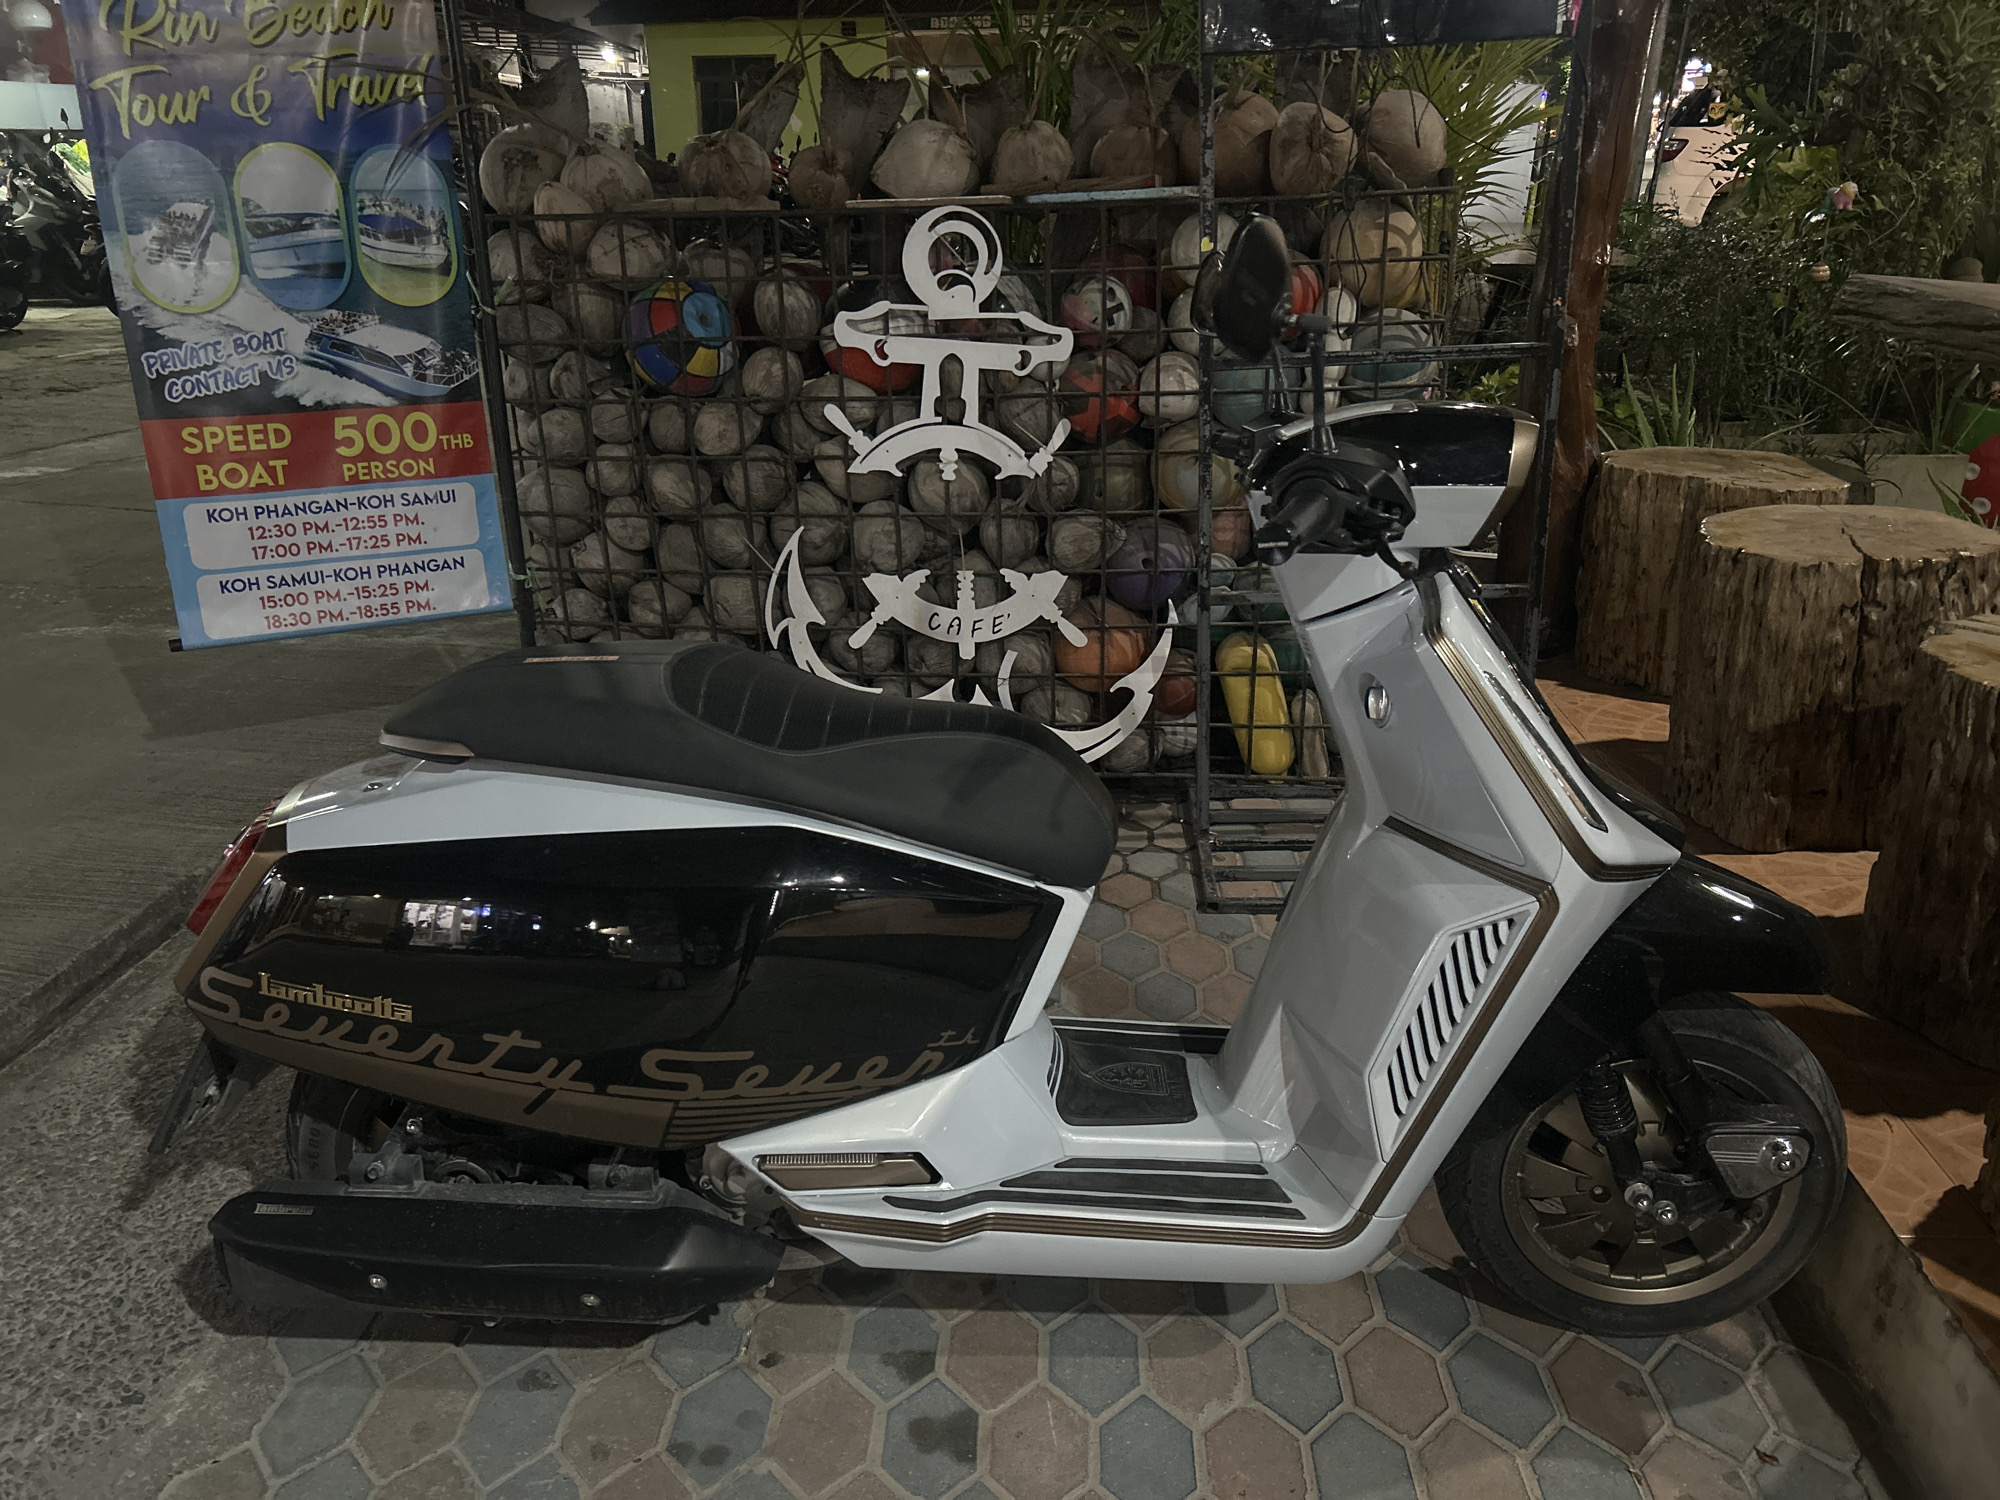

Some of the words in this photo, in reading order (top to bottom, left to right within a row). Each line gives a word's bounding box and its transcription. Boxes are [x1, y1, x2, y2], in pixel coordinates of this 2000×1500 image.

[101, 0, 219, 57] Rin
[225, 0, 394, 48] Beach
[89, 63, 211, 140] Tour
[230, 64, 272, 126] &
[287, 48, 435, 121] Travel
[143, 340, 225, 377] PRIVATE
[232, 327, 286, 357] BOAT
[167, 362, 260, 400] CONTACT
[267, 356, 295, 379] US
[181, 422, 292, 455] SPEED
[335, 411, 438, 457] 500
[439, 433, 475, 451] THB
[196, 460, 289, 491] BOAT
[342, 458, 435, 482] PERSON
[206, 507, 248, 524] KOH
[254, 494, 396, 520] PHANGAN-KOH
[400, 489, 457, 507] SAMUI
[247, 522, 297, 541] 12:30
[302, 514, 388, 536] PM.-12:55
[393, 512, 426, 528] PM.
[251, 542, 301, 560] 17:00
[306, 534, 391, 556] PM.-17:25
[395, 532, 428, 547] PM.
[219, 578, 261, 595] KOH
[266, 565, 372, 590] SAMUI-KOH
[377, 556, 466, 579] PHANGAN
[259, 592, 309, 610] 15:00
[314, 583, 399, 604] PM.-15:25
[404, 580, 435, 595] PM.
[264, 611, 312, 630] 18:30
[317, 602, 401, 624] PM.-18:55
[405, 599, 437, 614] PM.
[185, 966, 595, 1115] Seventy
[606, 1048, 945, 1099] Seven
